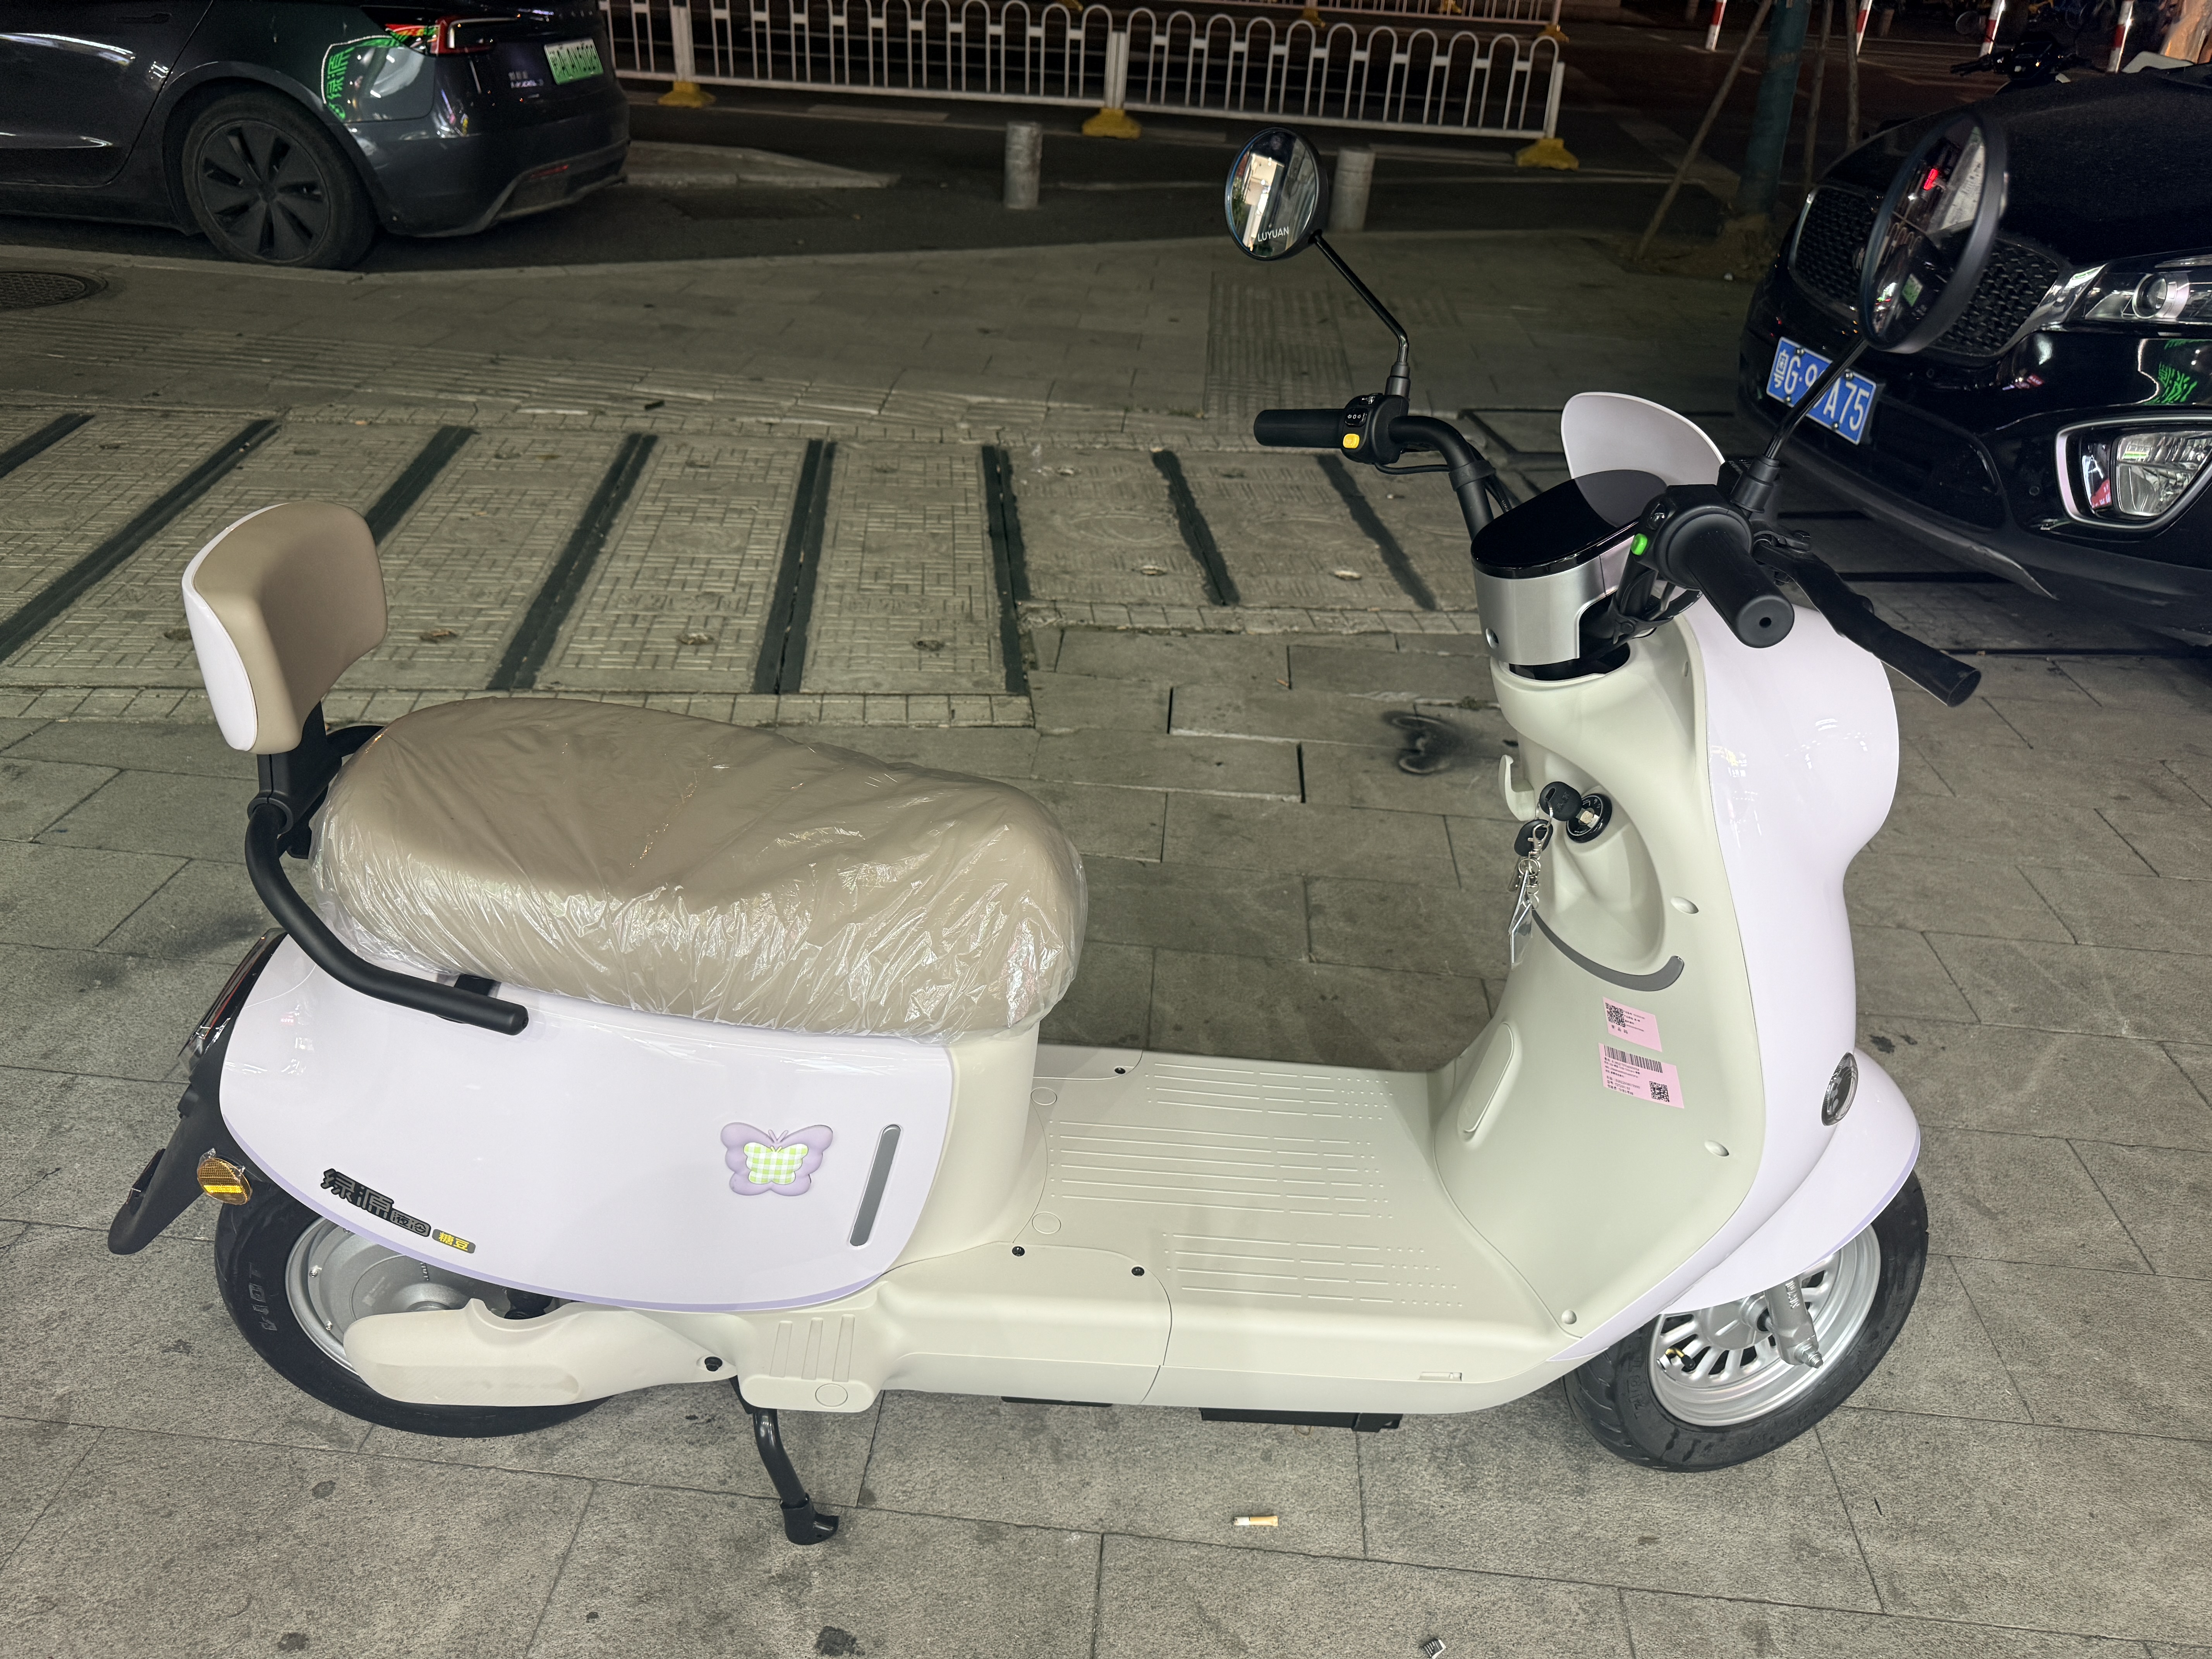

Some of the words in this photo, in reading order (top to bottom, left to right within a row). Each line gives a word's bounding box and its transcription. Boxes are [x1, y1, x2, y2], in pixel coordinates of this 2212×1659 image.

[1258, 227, 1289, 242] LUYUAN
[1774, 349, 1869, 431] 粤G·9A75
[321, 1169, 394, 1219] 绿源
[393, 1211, 427, 1233] 液冷
[438, 1231, 469, 1251] 糖豆
